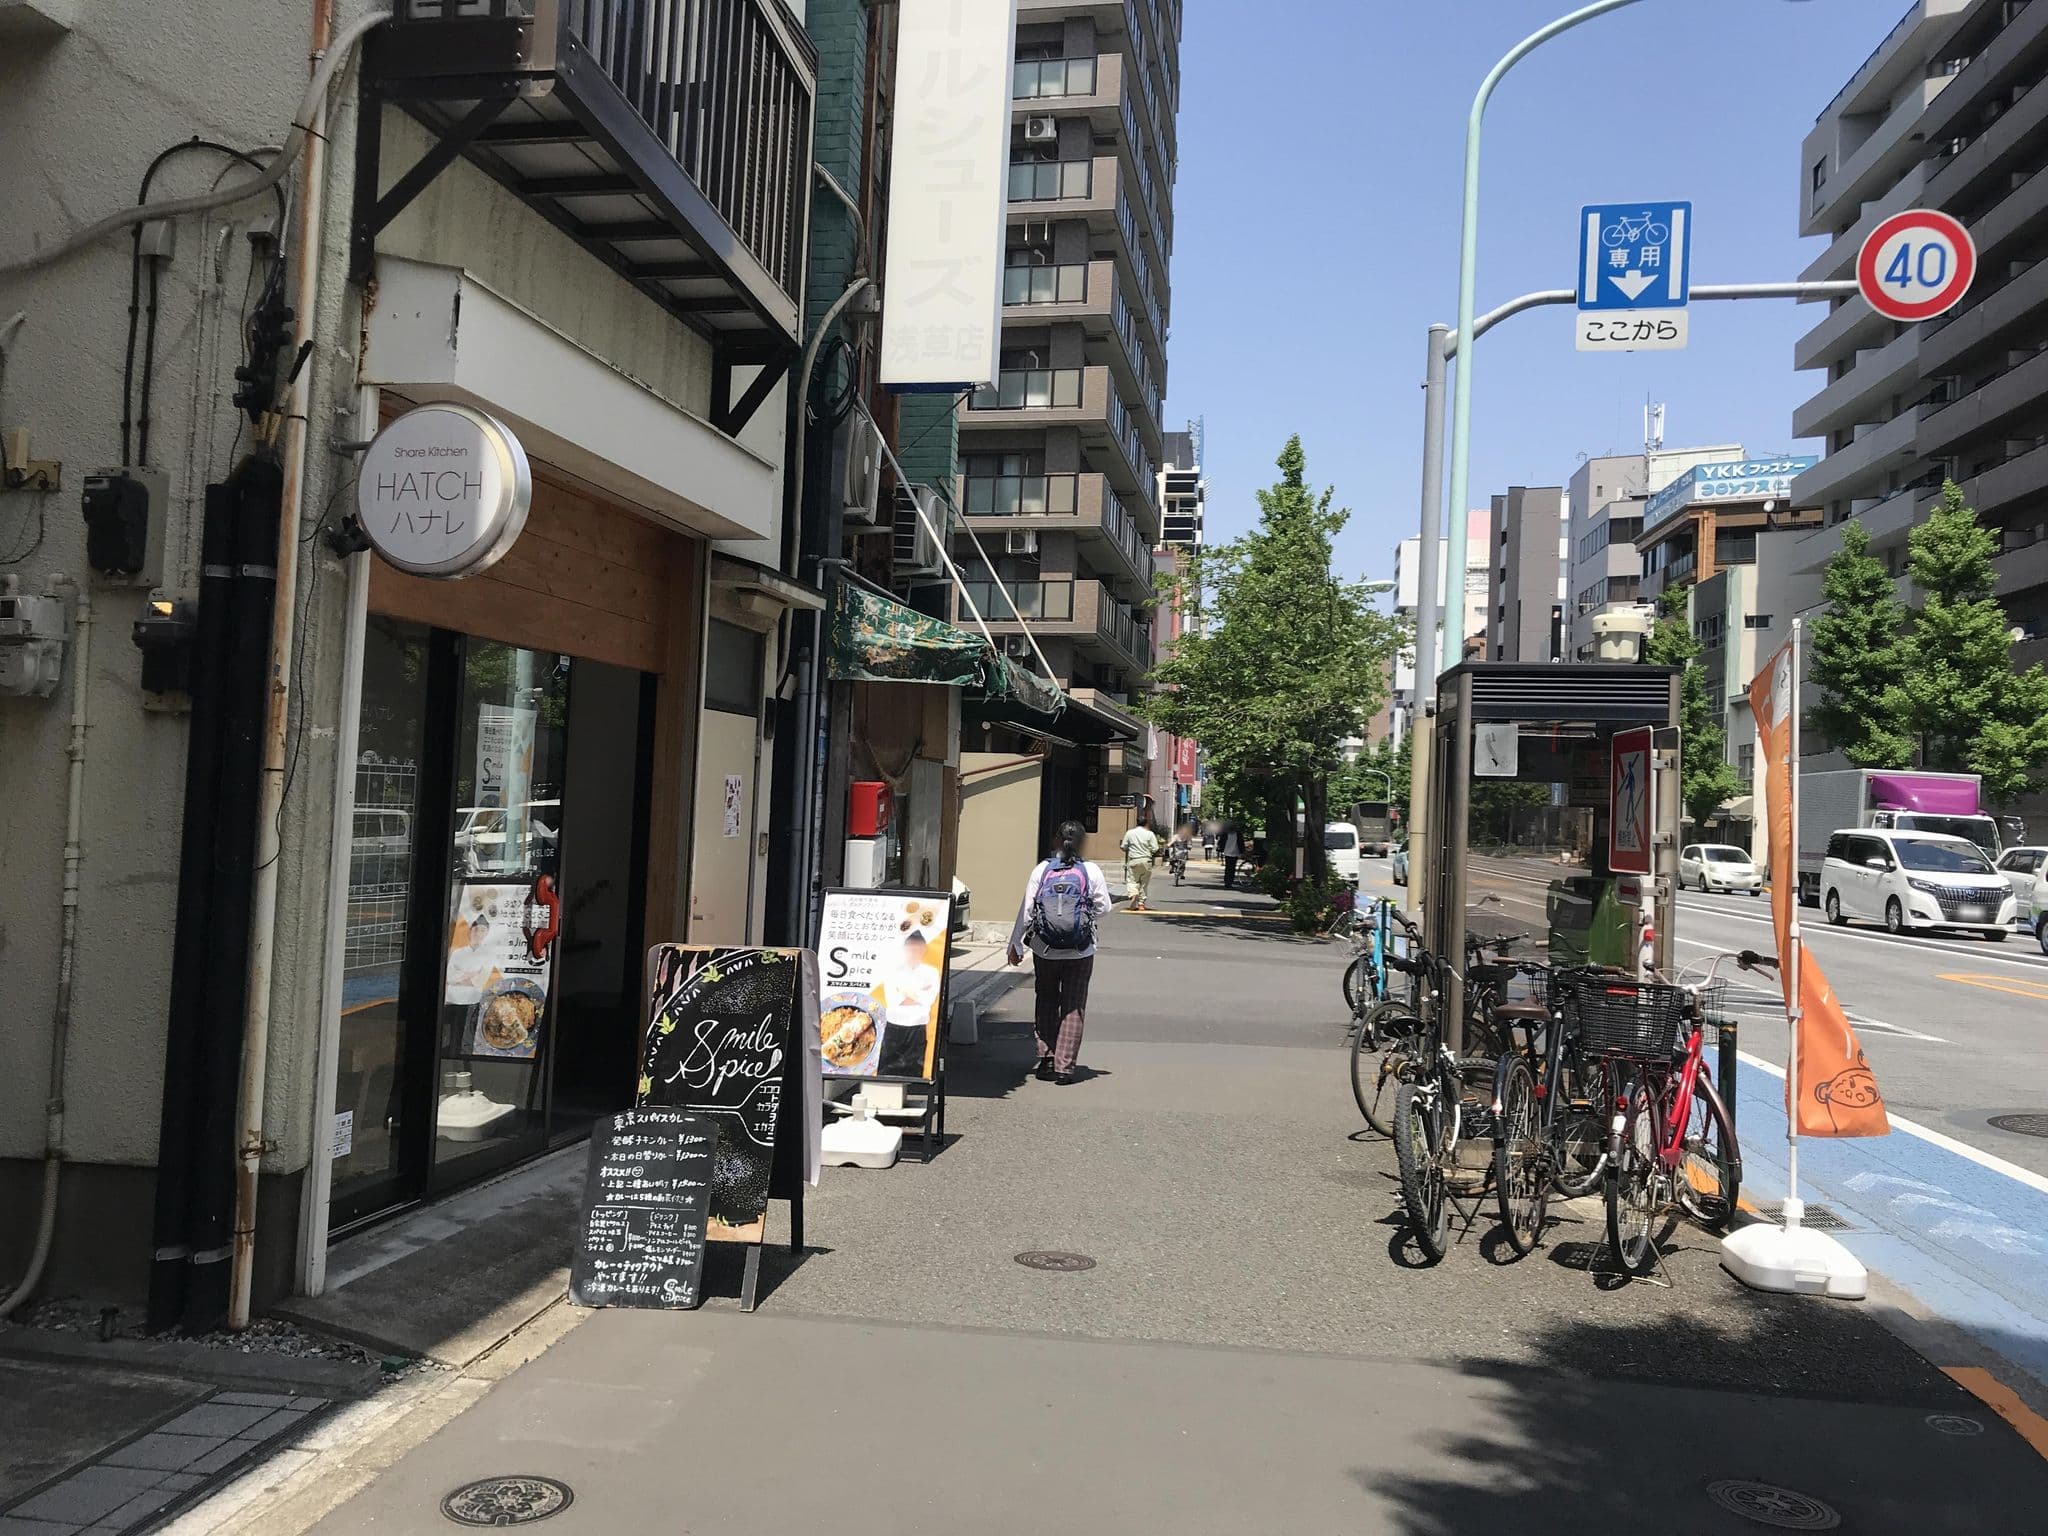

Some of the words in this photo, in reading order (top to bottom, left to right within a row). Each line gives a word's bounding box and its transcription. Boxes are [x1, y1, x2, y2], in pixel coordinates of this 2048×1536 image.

[1608, 246, 1660, 268] 専用
[1884, 242, 1947, 288] 40
[1586, 320, 1678, 342] ここから
[394, 447, 425, 458] Share
[428, 446, 468, 458] Kitchen
[1702, 463, 1746, 480] YKK
[1749, 461, 1807, 475] ファスナー
[377, 470, 482, 501] HATCH
[390, 509, 464, 535] ハナレ
[830, 910, 896, 921] 毎日食べたくなる
[830, 921, 897, 931] こころとおなかが
[827, 931, 896, 941] 笑顔になるカレー
[827, 946, 877, 972] Smile
[665, 1013, 780, 1086] Smile
[613, 1111, 696, 1131] 東京スパイスカレー
